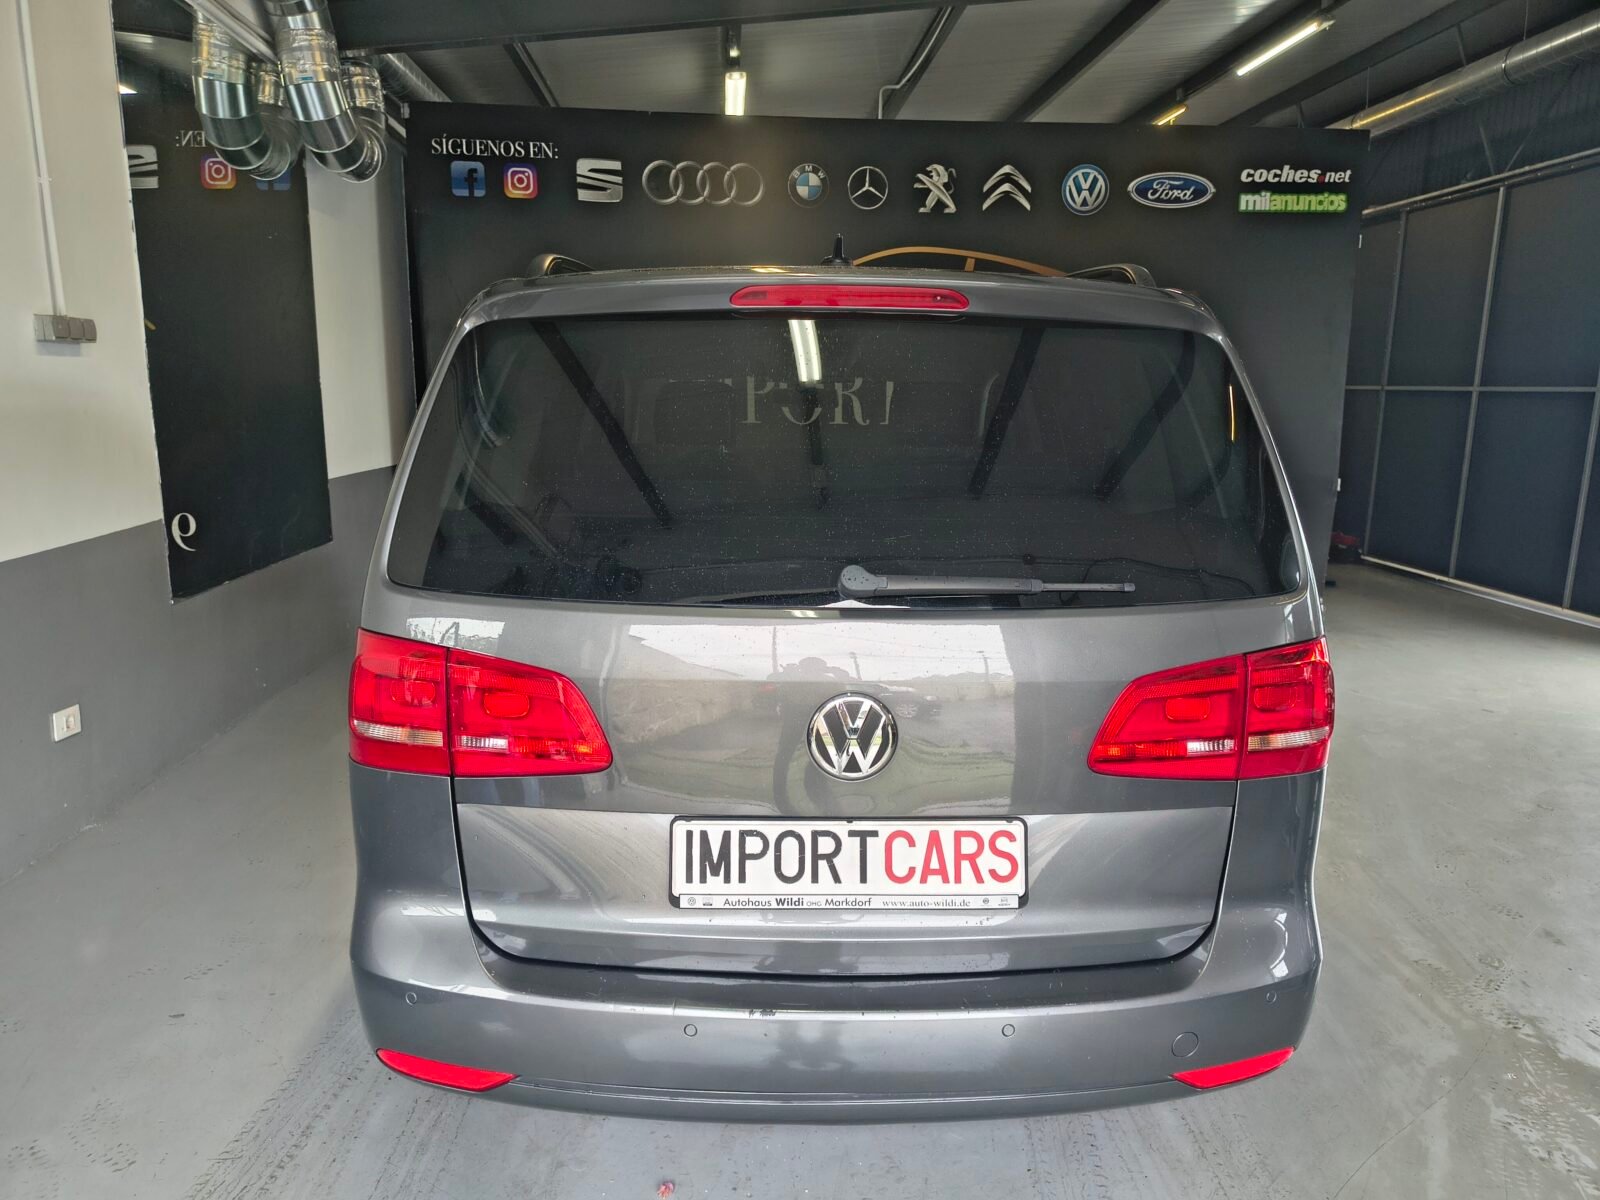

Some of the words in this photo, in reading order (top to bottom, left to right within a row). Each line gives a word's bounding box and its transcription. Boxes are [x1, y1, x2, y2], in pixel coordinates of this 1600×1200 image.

[430, 134, 525, 158] SÍGUENOS
[529, 141, 559, 160] EN:
[1240, 165, 1352, 183] coches.net
[1147, 179, 1194, 201] Ford
[1238, 191, 1348, 212] milanuncios
[723, 898, 772, 907] Autohaus
[775, 897, 804, 907] Wildi
[824, 897, 872, 907] Markdorf
[882, 897, 971, 908] www.auto-wildi.de
